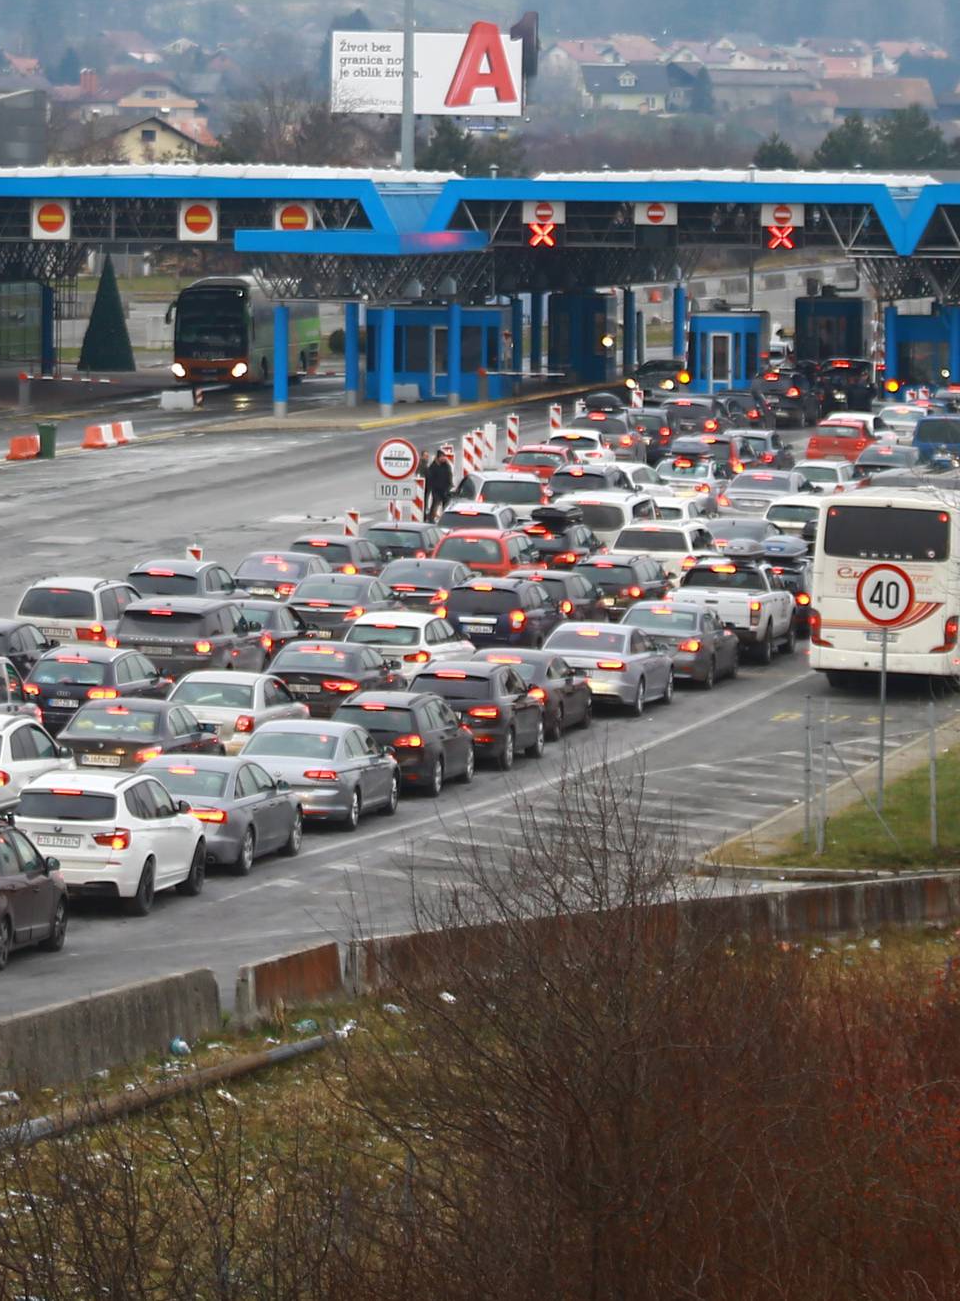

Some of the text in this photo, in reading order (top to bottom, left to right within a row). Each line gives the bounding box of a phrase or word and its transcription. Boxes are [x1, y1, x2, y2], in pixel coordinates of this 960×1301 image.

[339, 39, 392, 53] Život bez
[339, 55, 383, 68] granica
[340, 67, 350, 79] je
[353, 66, 381, 78] oblik
[381, 484, 412, 497] 100 m
[869, 580, 900, 610] 40
